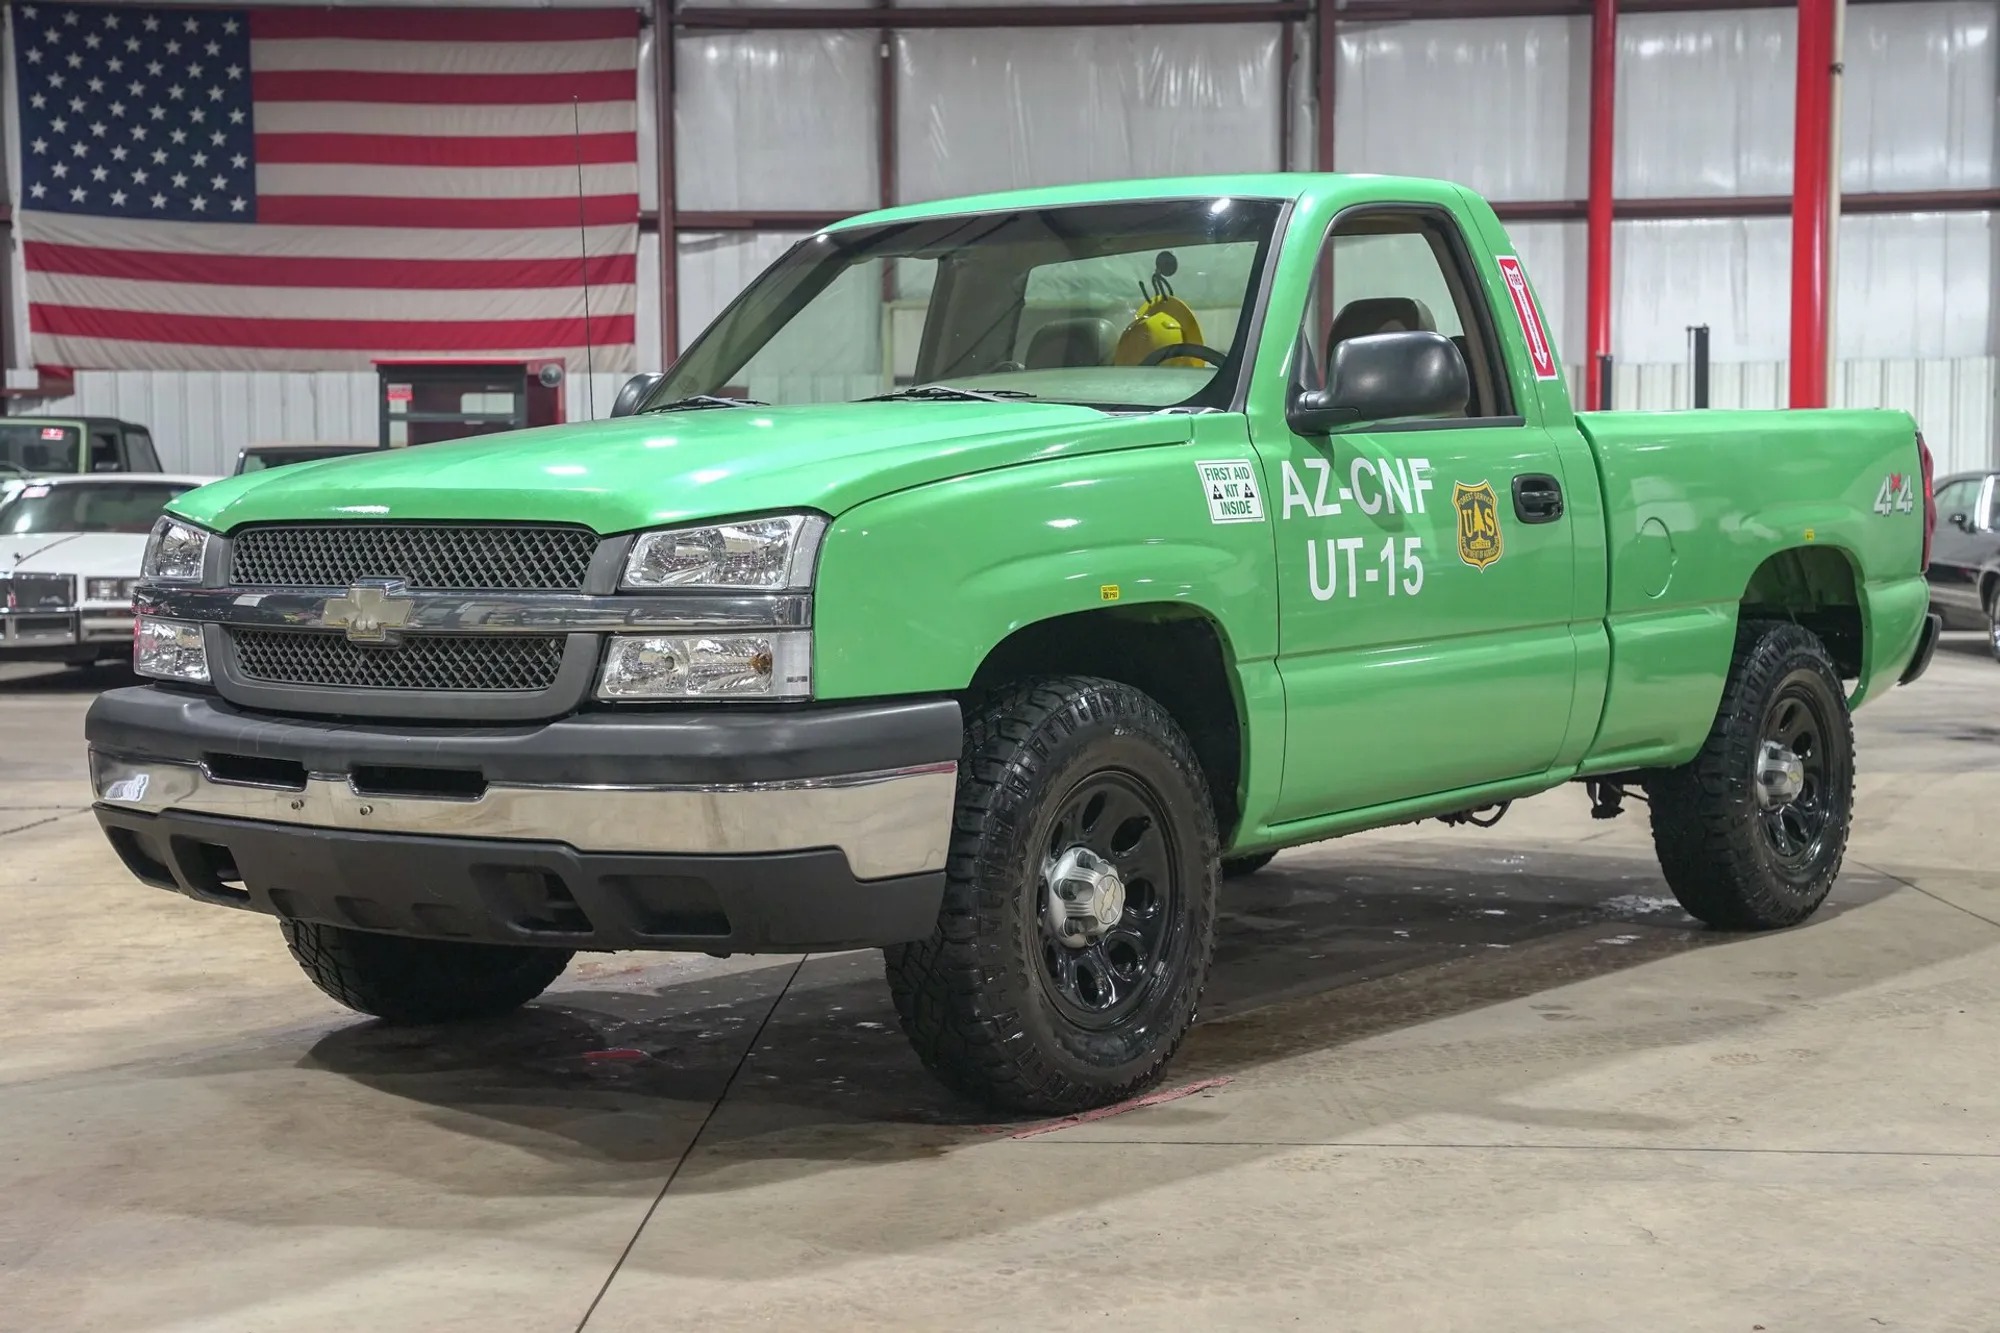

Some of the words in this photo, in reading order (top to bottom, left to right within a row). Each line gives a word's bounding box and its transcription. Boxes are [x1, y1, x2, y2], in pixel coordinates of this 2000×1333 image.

[1204, 467, 1232, 481] FIRST
[1233, 466, 1250, 480] AID
[1223, 483, 1239, 498] KIT
[1282, 457, 1433, 520] AZ-CNF
[1220, 500, 1253, 515] INSIDE
[1307, 536, 1424, 601] UT-15
